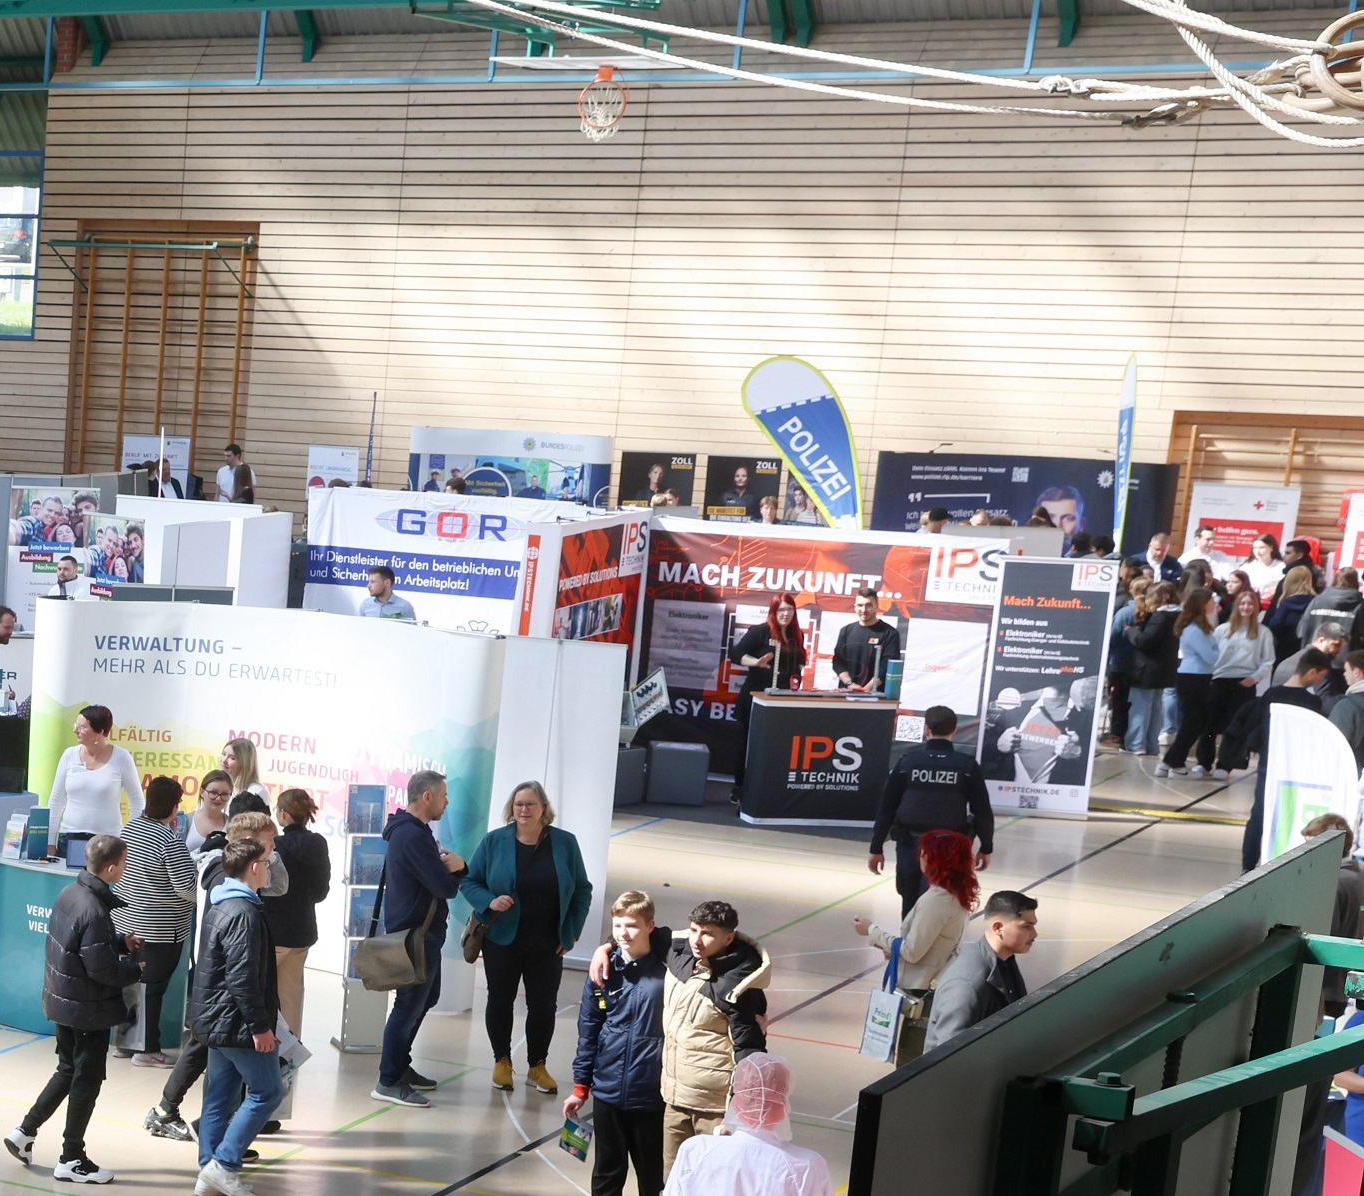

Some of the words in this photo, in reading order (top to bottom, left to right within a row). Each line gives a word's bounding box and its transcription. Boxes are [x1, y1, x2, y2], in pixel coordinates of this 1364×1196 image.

[671, 456, 693, 466] ZOLL
[756, 461, 778, 471] ZOLL
[776, 415, 852, 502] POLIZEI
[310, 549, 324, 562] Ihr
[325, 549, 389, 569] Dienstleister
[390, 554, 406, 570] für
[408, 557, 429, 571] den
[432, 558, 502, 577] betrieblichen
[504, 565, 520, 579] Un
[309, 567, 328, 580] und
[331, 566, 369, 582] Sicherh
[657, 560, 741, 588] MACH
[1078, 564, 1114, 582] IPS
[404, 573, 470, 592] Arbeitsplatz!
[1003, 595, 1034, 607] Mach
[1036, 596, 1091, 610] Zukunft...
[668, 610, 709, 621] Elektroniker
[1001, 617, 1013, 625] Wir
[1013, 617, 1035, 627] bilden
[1005, 629, 1046, 639] Elektroniker
[94, 634, 225, 655] VERWALTUNG
[1003, 645, 1044, 655] Elektroniker
[92, 657, 146, 674] MEHR
[152, 659, 187, 677] ALS
[194, 661, 221, 678] DU
[228, 663, 337, 689] ERWARTEST!
[228, 728, 316, 755] MODERN
[789, 735, 864, 772] IPS
[267, 758, 359, 784] JUGENDLICH
[801, 771, 860, 784] TECHNIK
[911, 768, 959, 785] POLIZEI
[786, 783, 816, 791] POWERED
[824, 784, 859, 792] SOLUTIONS
